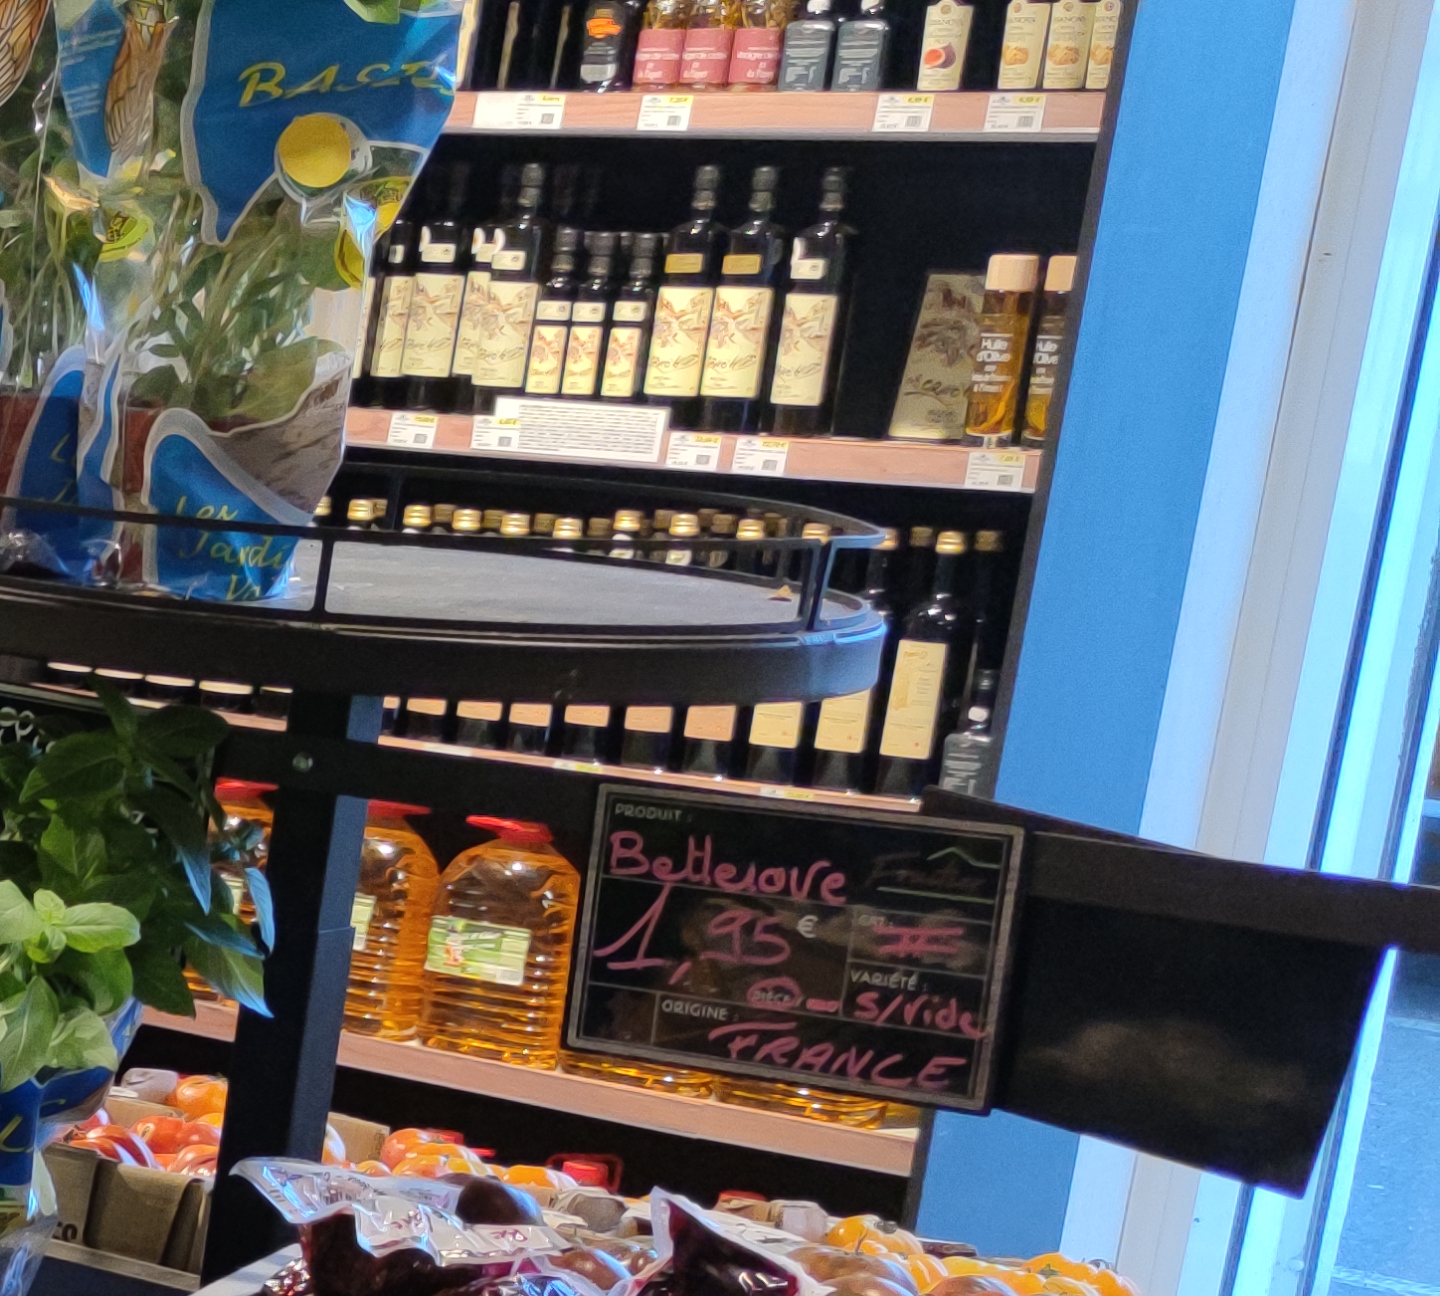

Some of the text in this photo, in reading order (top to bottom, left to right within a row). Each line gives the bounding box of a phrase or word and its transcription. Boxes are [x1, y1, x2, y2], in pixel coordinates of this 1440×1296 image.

[614, 803, 682, 823] PRODUIT
[797, 915, 819, 939] €
[850, 968, 919, 991] VARIÉTÉ
[661, 1000, 730, 1022] ORIGINE
